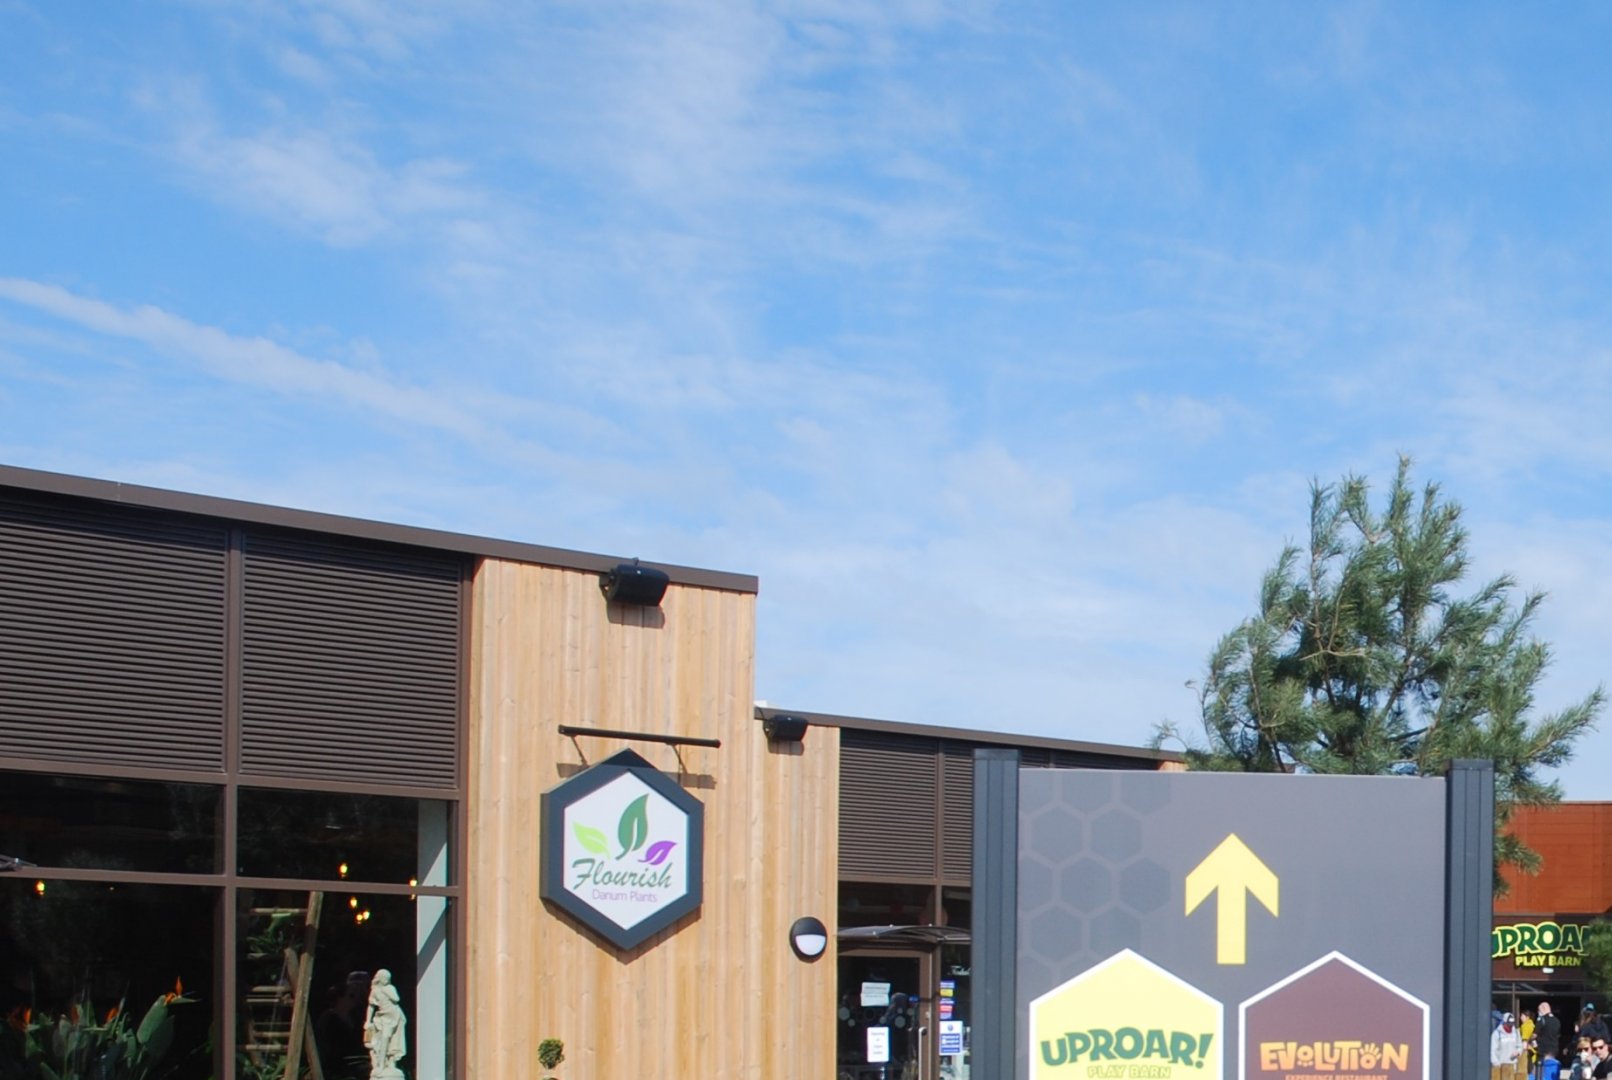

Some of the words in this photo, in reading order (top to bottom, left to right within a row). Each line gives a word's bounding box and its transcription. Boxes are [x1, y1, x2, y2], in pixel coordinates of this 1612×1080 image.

[572, 858, 673, 890] Flourish
[592, 889, 628, 901] Danum
[630, 890, 657, 903] Plants
[1515, 955, 1546, 967] PLAY
[1548, 955, 1581, 967] BARN
[1040, 1026, 1214, 1069] UPROAR!
[1260, 1040, 1409, 1072] EVOLUTION
[1086, 1065, 1127, 1079] PLAY
[1129, 1065, 1171, 1079] BARN
